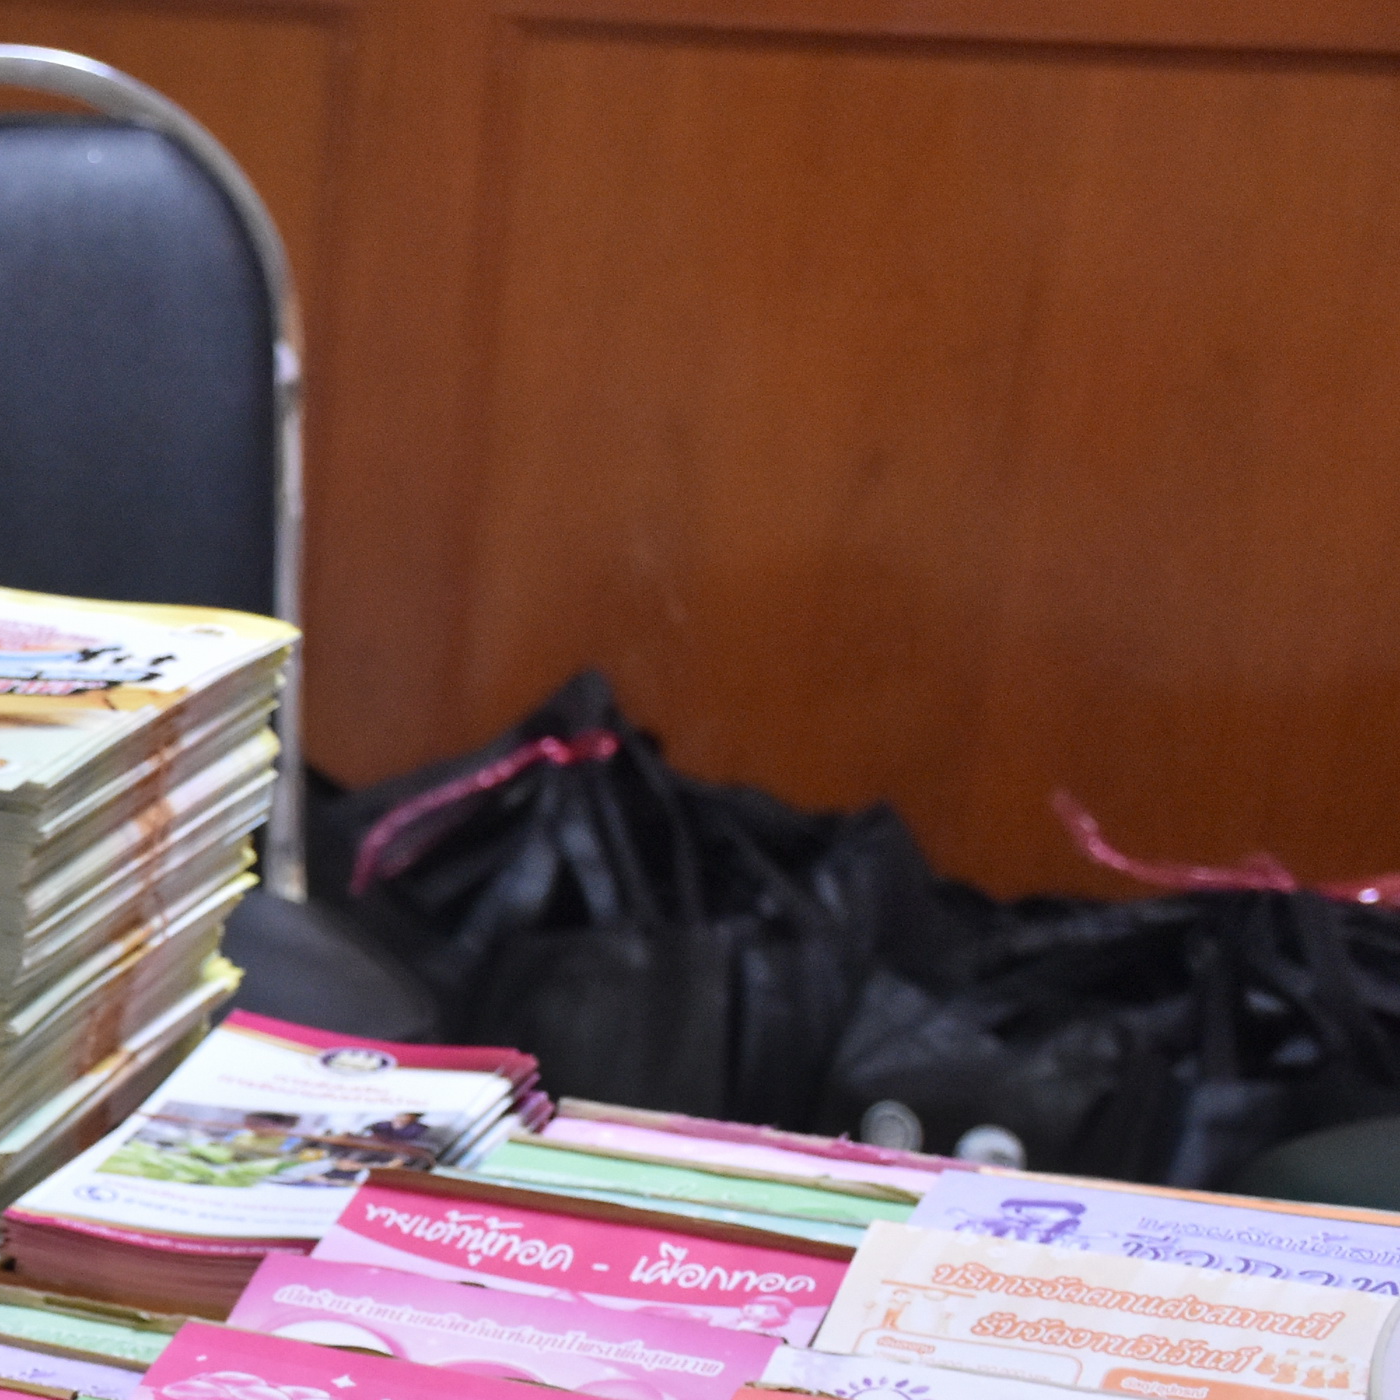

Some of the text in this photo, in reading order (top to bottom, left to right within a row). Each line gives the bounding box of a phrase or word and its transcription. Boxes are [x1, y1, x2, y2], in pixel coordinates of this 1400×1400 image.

[363, 1201, 575, 1274] ขายเต้าหู้ทอด
[630, 1241, 817, 1295] เผือกทอด
[931, 1261, 1346, 1340] บริการจัดตกแต่งสถานที่
[970, 1311, 1263, 1374] รับจัดงานอีเว้นท์
